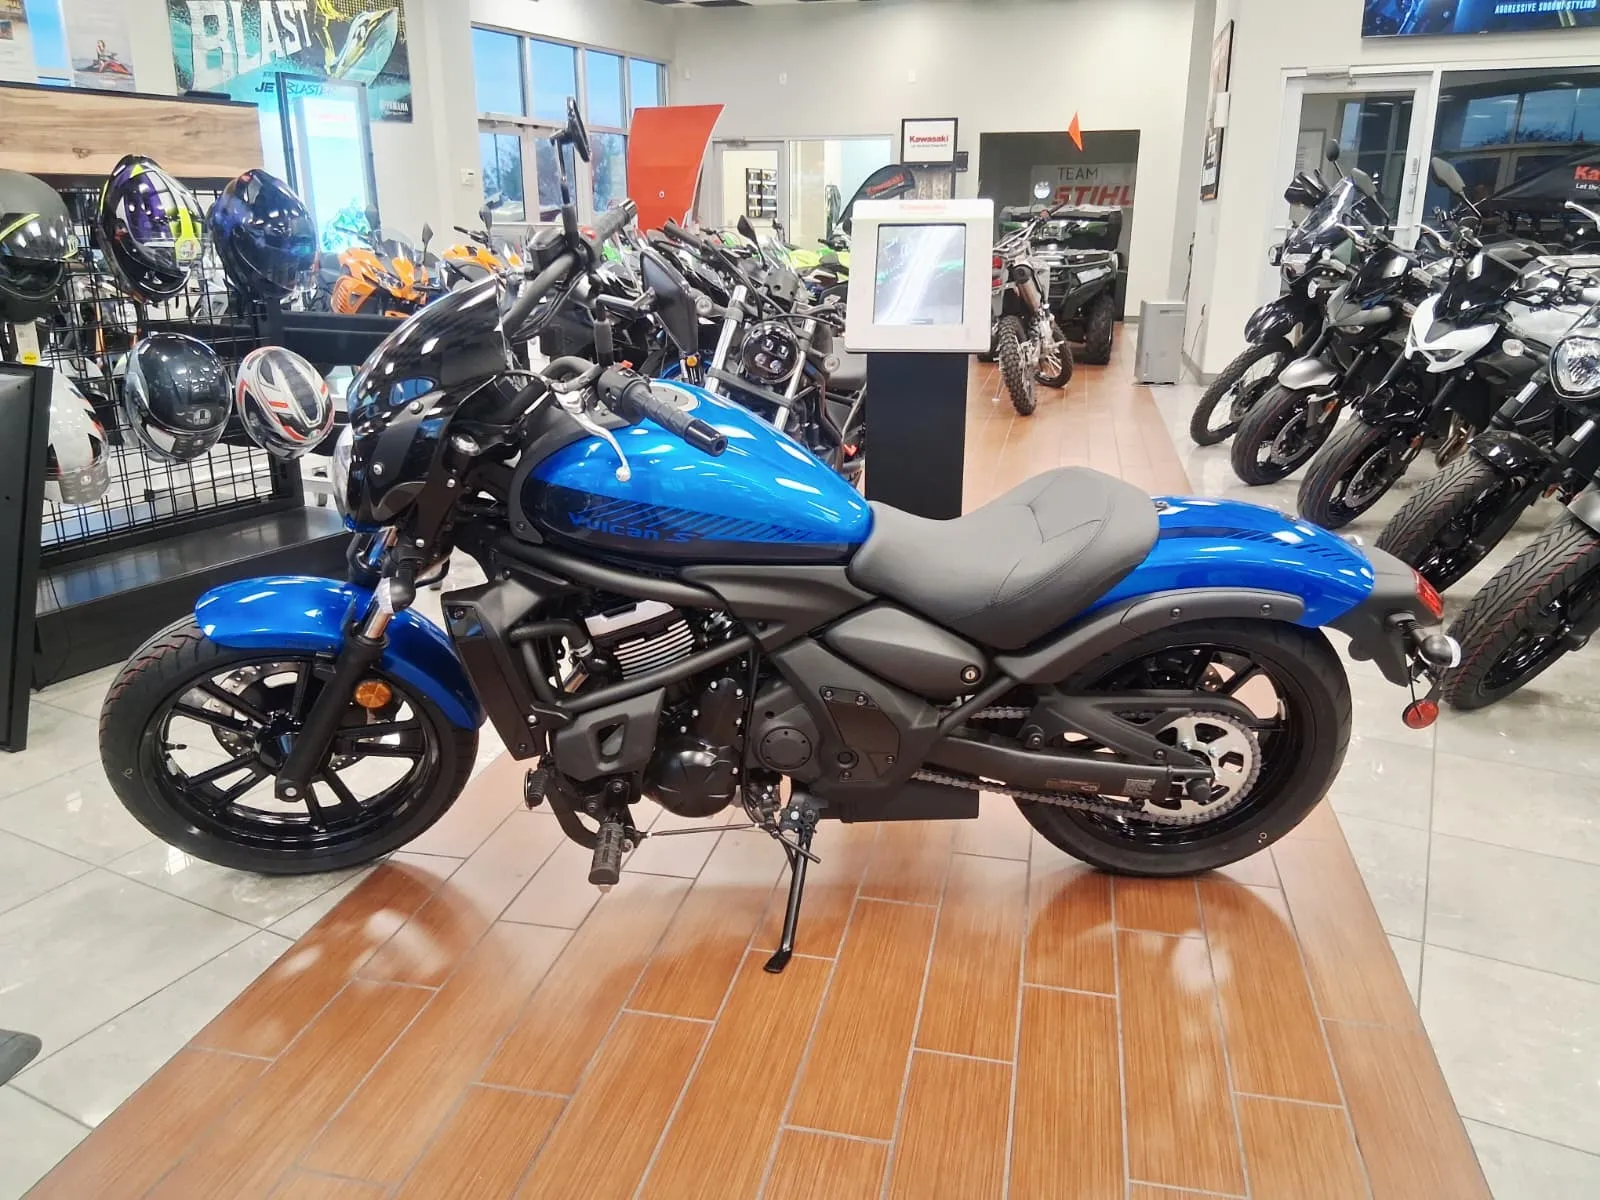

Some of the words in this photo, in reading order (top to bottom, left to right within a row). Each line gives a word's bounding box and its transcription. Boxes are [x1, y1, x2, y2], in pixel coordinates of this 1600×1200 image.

[187, 0, 312, 92] BLAST
[255, 82, 275, 93] JE
[909, 134, 949, 143] Kawasaki
[1058, 167, 1098, 180] TEAM
[1052, 186, 1133, 206] STIHL
